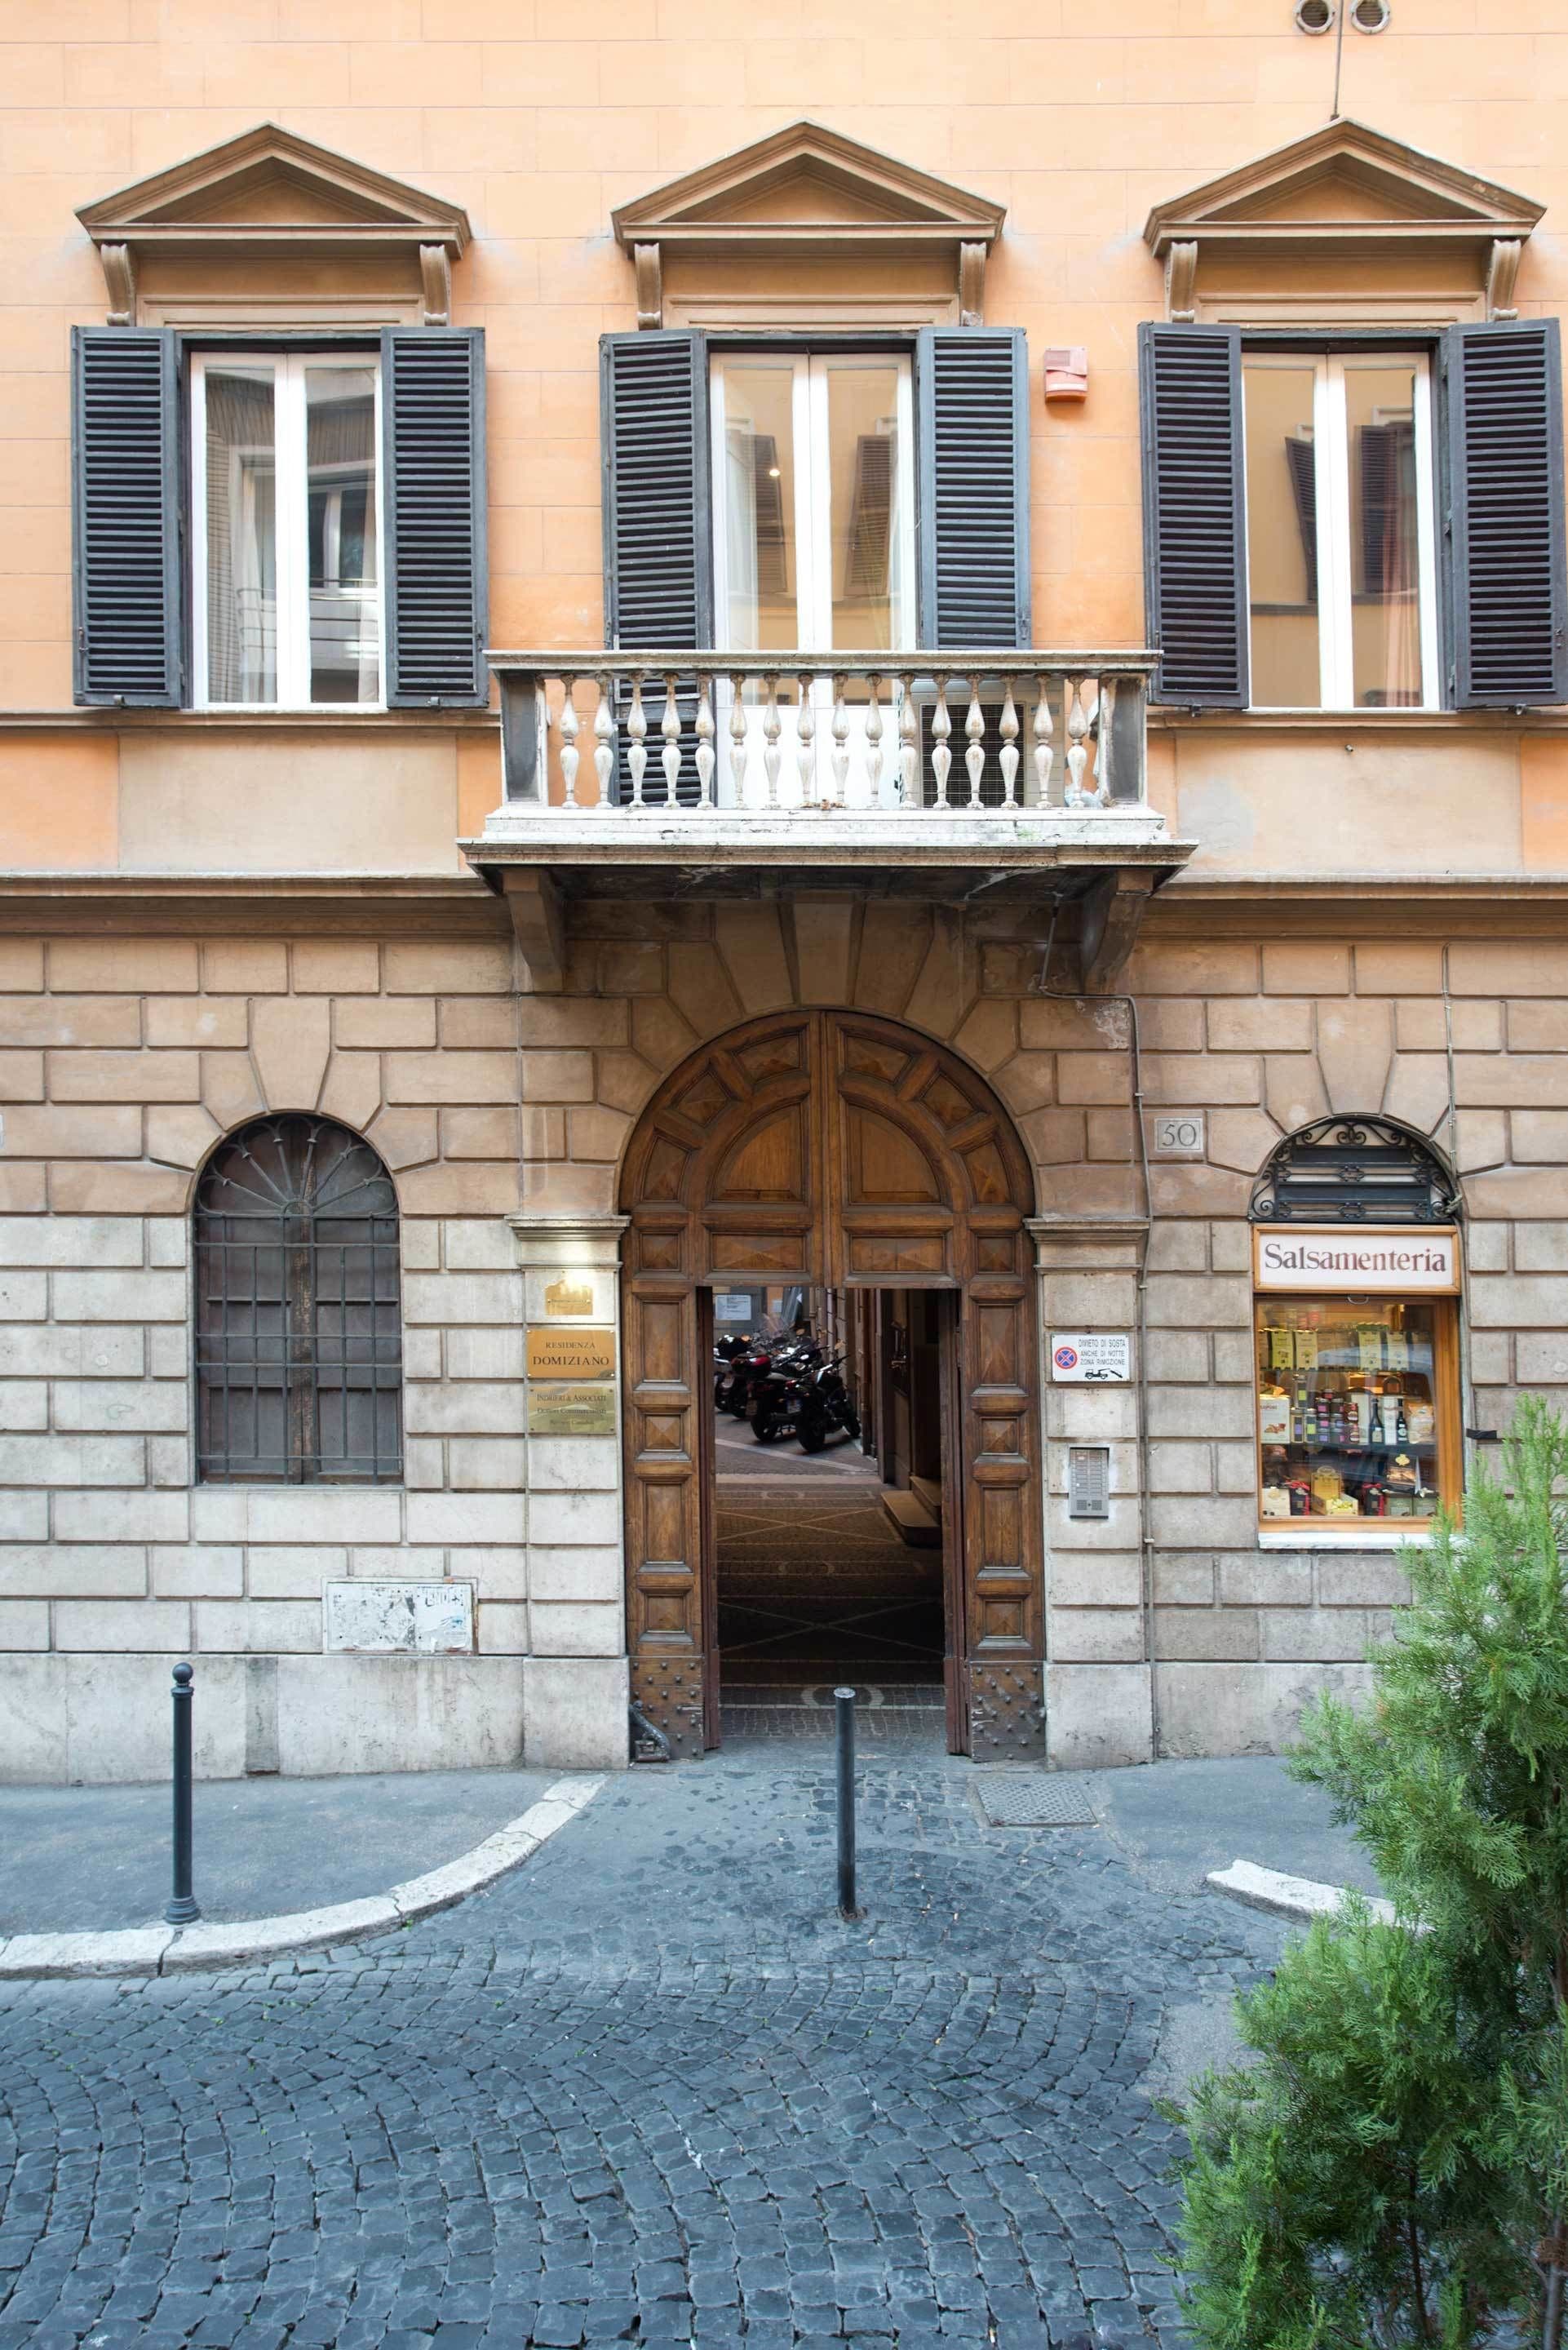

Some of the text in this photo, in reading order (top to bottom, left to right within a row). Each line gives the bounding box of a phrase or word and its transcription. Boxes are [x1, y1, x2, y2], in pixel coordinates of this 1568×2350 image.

[1161, 1123, 1197, 1146] 50
[1265, 1243, 1447, 1273] Salsamenteria
[1079, 1339, 1126, 1347] DIVIETO DI SOSTA
[533, 1356, 610, 1366] DOMIZIANO
